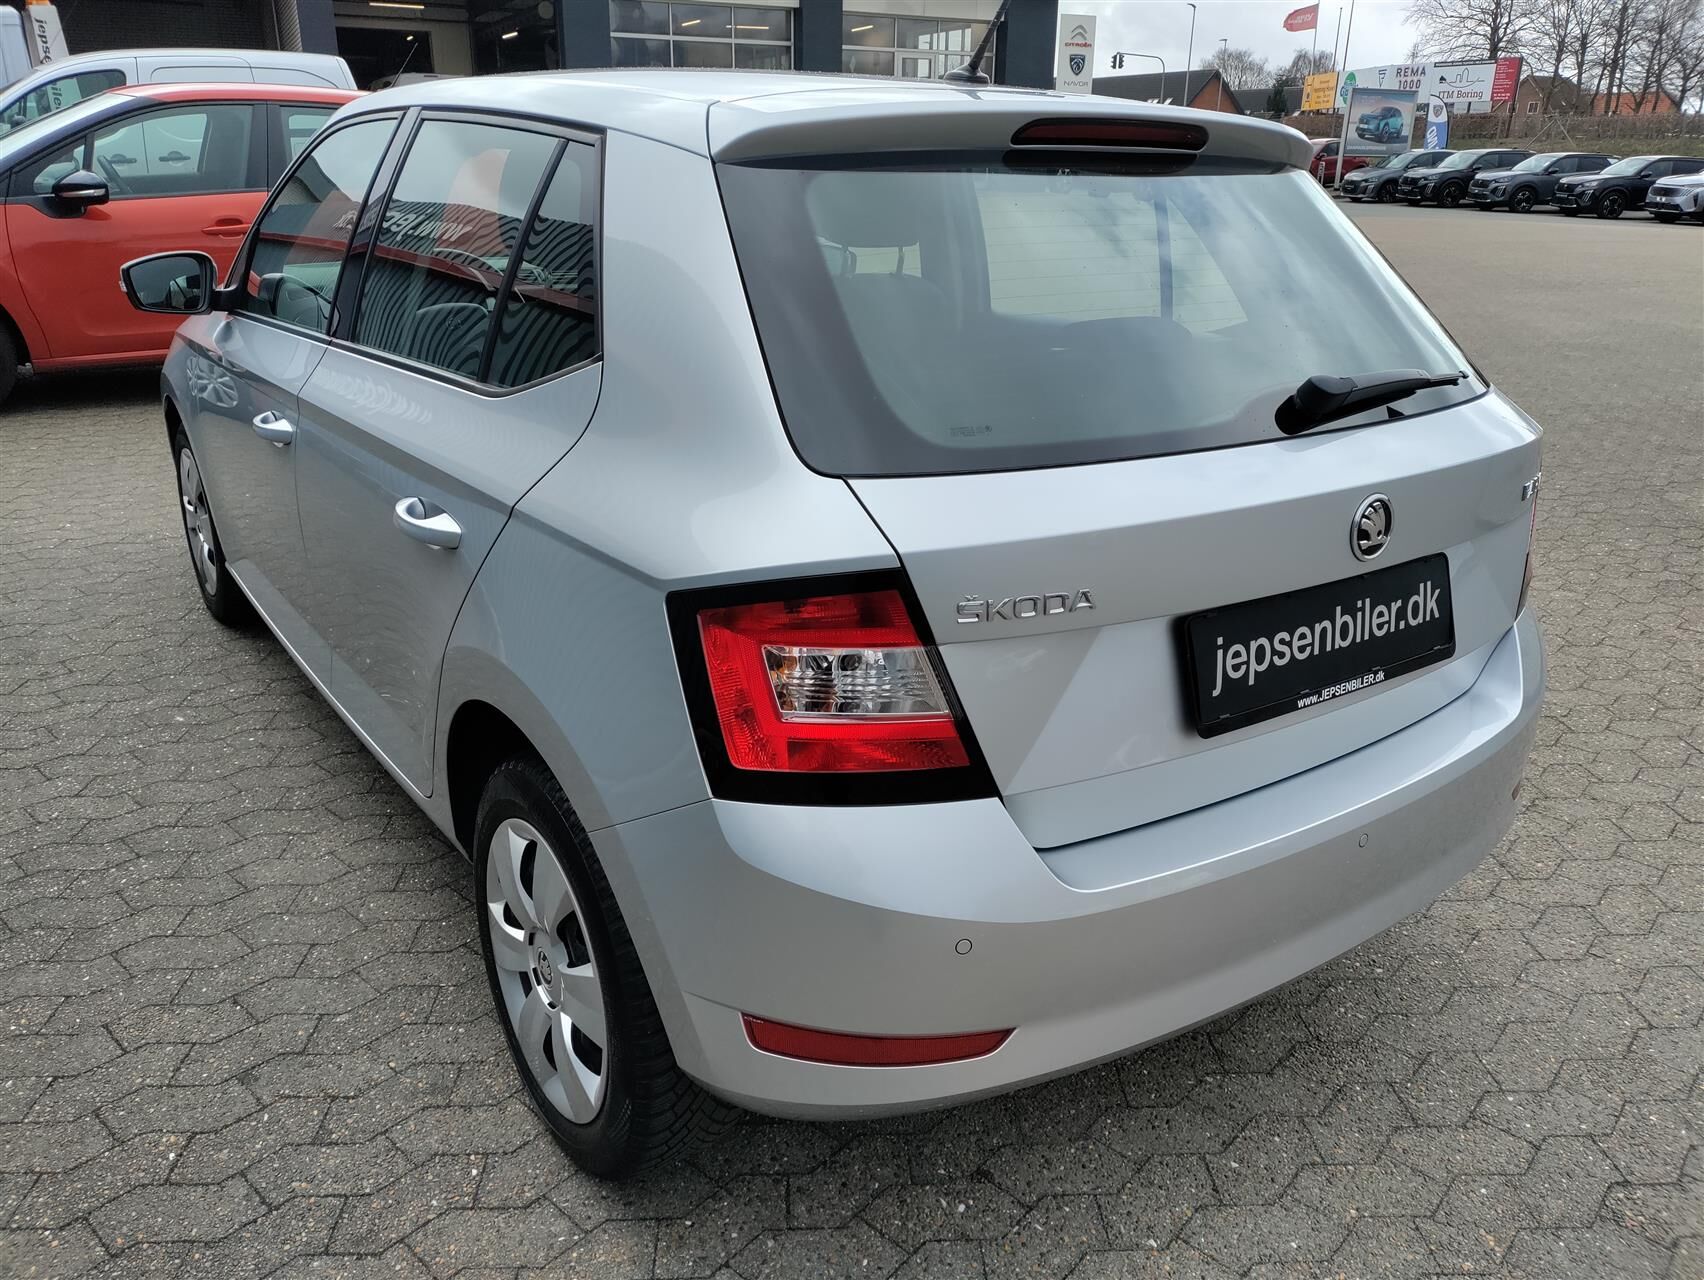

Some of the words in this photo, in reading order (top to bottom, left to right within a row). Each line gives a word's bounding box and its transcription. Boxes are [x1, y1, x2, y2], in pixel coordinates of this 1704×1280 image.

[1396, 65, 1426, 78] REMA
[1398, 79, 1421, 90] 1000
[1456, 88, 1483, 100] Boring
[957, 588, 1096, 624] ŠKODA
[1212, 580, 1441, 697] jepsenbiler.dk
[1297, 670, 1385, 708] www.JEPSENBILER.dk
